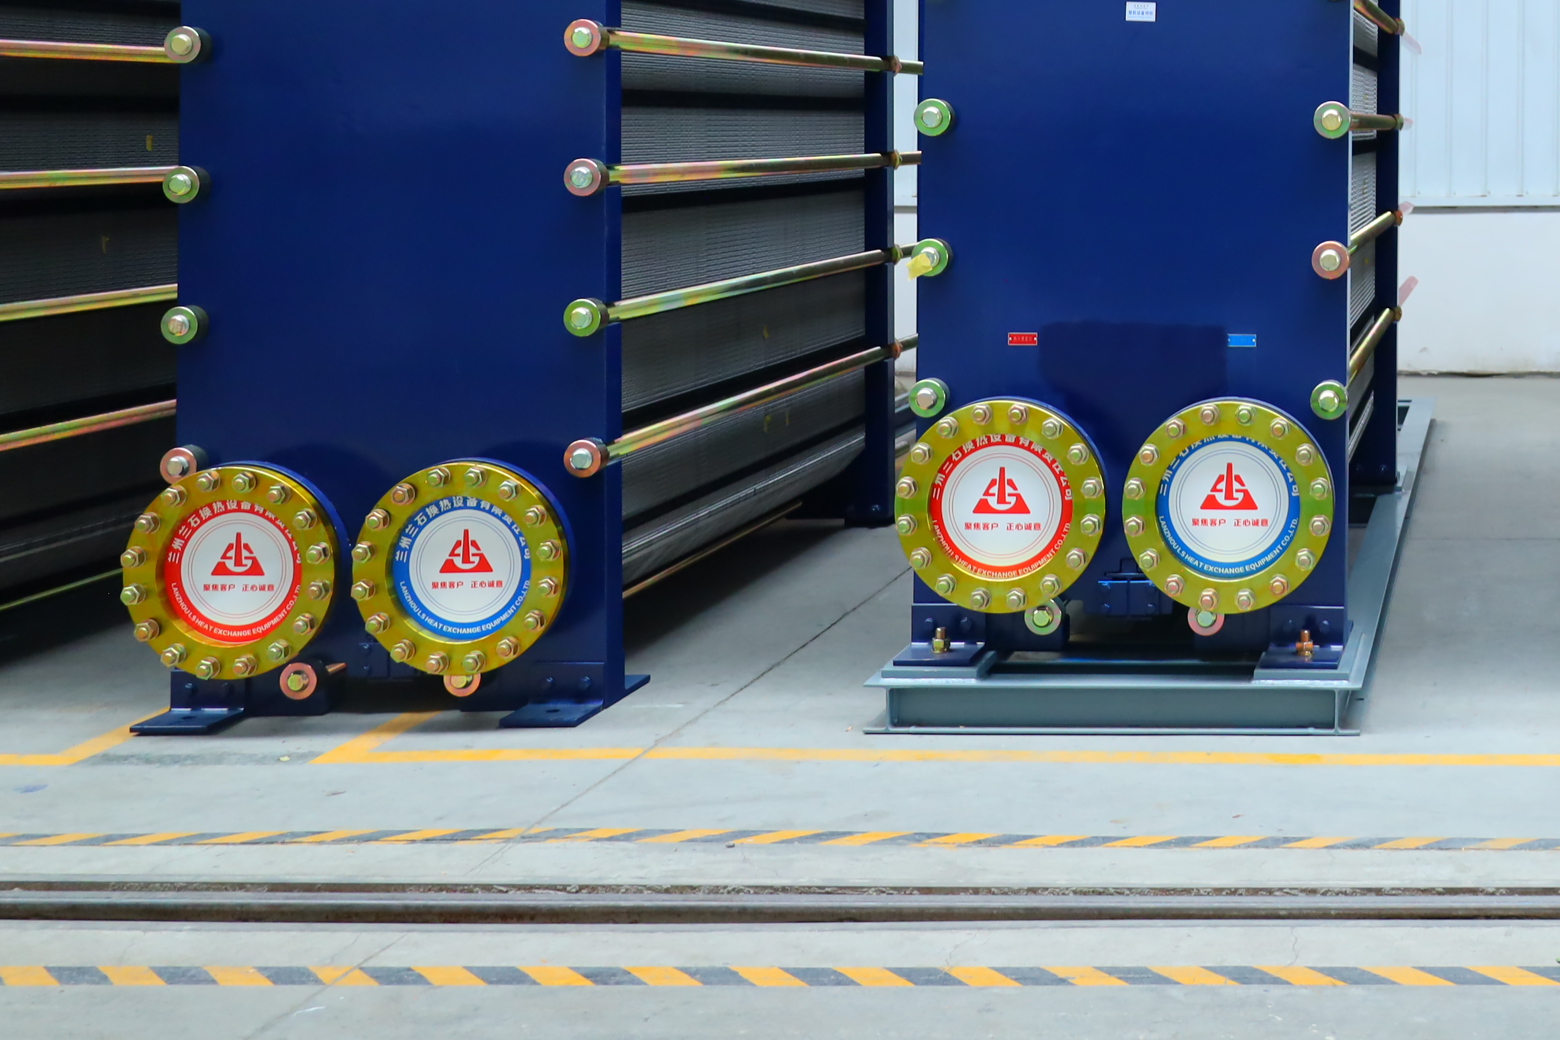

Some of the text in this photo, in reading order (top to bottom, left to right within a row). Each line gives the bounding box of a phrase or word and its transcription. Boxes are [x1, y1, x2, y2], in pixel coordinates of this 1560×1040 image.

[1006, 523, 1042, 531] 正心诚意
[1158, 515, 1179, 550] LANZHOU
[1183, 553, 1204, 569] HEAT
[1203, 563, 1244, 574] EXCHANGE
[1244, 543, 1284, 572] EQUIPMENT
[957, 557, 977, 572] HEAT
[976, 567, 1017, 577] EXCHANGE
[1017, 547, 1056, 575] EQUIPMENT
[203, 584, 275, 592] 聚焦客户 正心诚意
[399, 580, 419, 612] LANZHOU
[424, 615, 443, 630] HEAT
[442, 623, 481, 634] EXCHANGE
[481, 604, 518, 631] EQUIPMENT
[170, 582, 191, 614] LANZHOU
[195, 617, 214, 632] HEAT
[212, 626, 251, 637] EXCHANGE
[251, 608, 289, 634] EQUIPMENT
